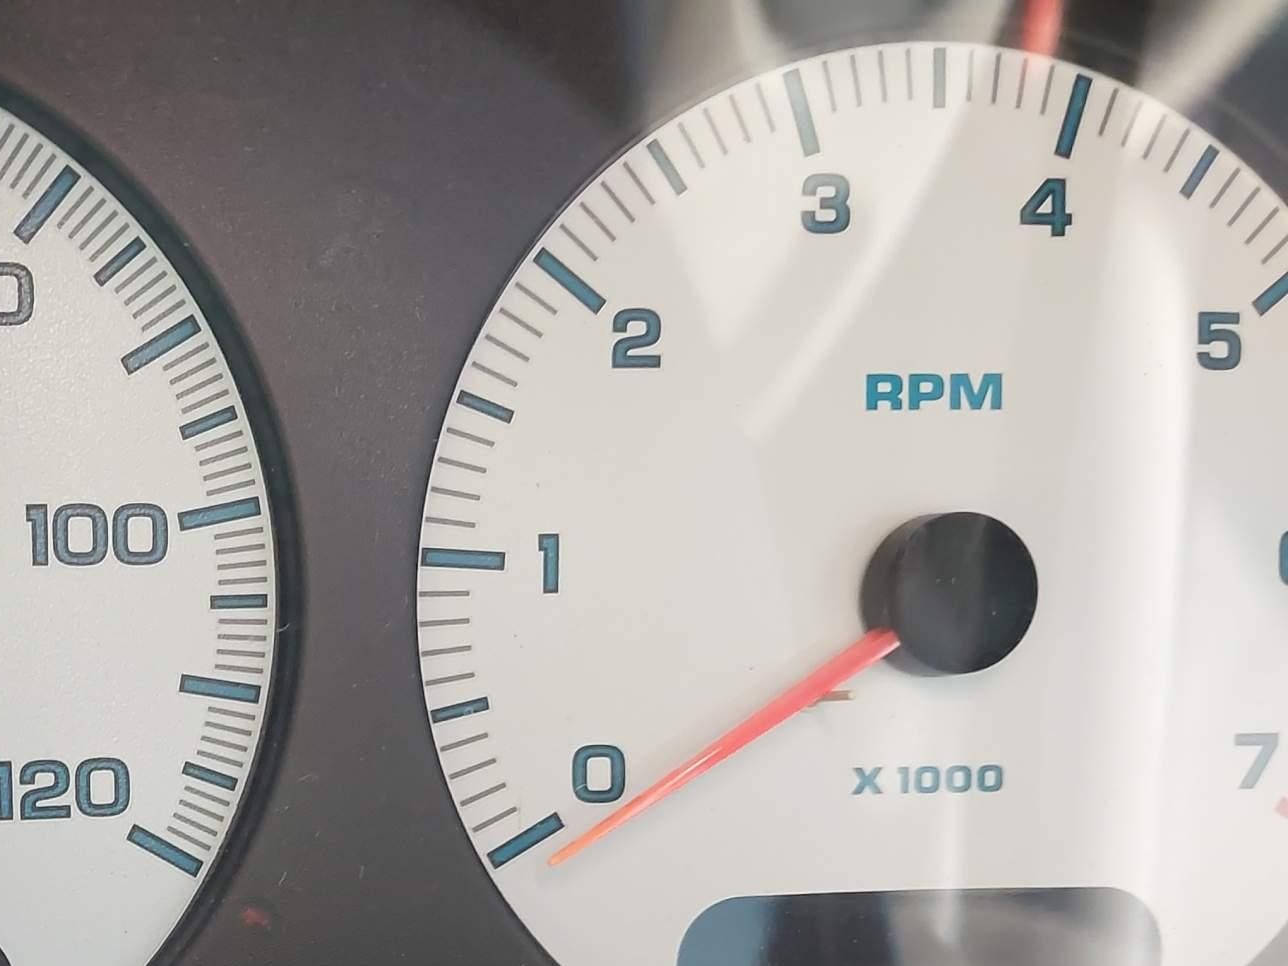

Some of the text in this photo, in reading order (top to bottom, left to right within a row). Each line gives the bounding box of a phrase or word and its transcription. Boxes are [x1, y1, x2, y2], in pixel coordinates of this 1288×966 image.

[800, 173, 851, 235] 3
[1019, 178, 1073, 237] 4
[611, 308, 661, 369] 2
[1196, 311, 1242, 371] 5
[864, 373, 1003, 412] RPM
[25, 502, 169, 567] 100
[537, 533, 560, 594] 1
[571, 743, 626, 804] 0
[851, 764, 1004, 796] X 1000
[1234, 732, 1280, 791] 7
